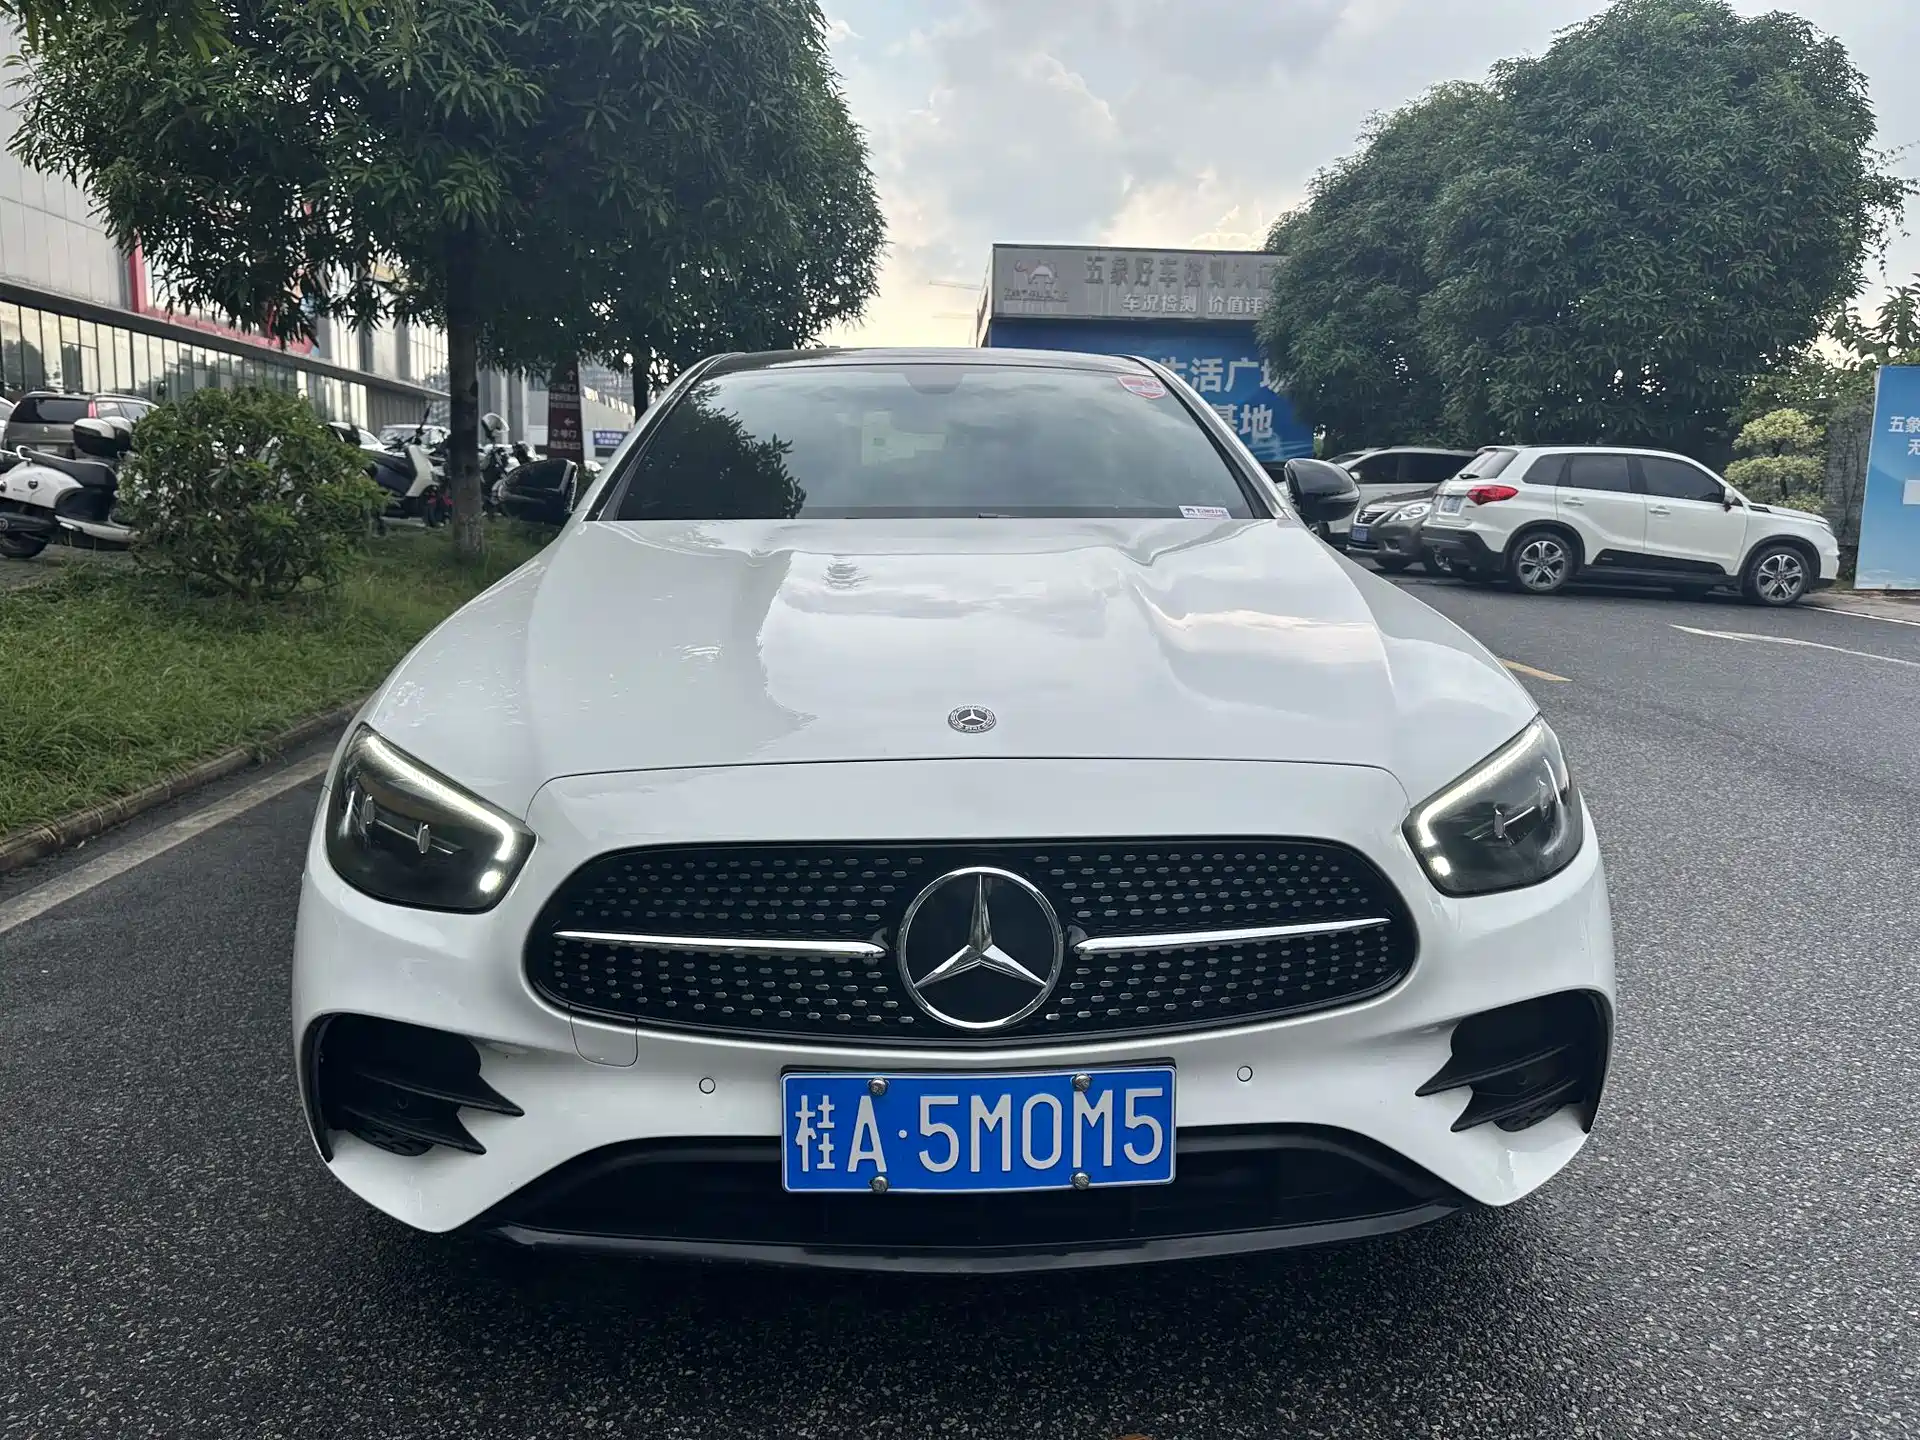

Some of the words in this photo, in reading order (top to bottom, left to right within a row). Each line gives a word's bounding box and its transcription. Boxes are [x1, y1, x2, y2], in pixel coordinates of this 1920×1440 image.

[1122, 293, 1197, 313] 车况检测
[1207, 294, 1268, 315] 价值评
[1211, 404, 1273, 444] 基地
[1888, 416, 1920, 433] 五象
